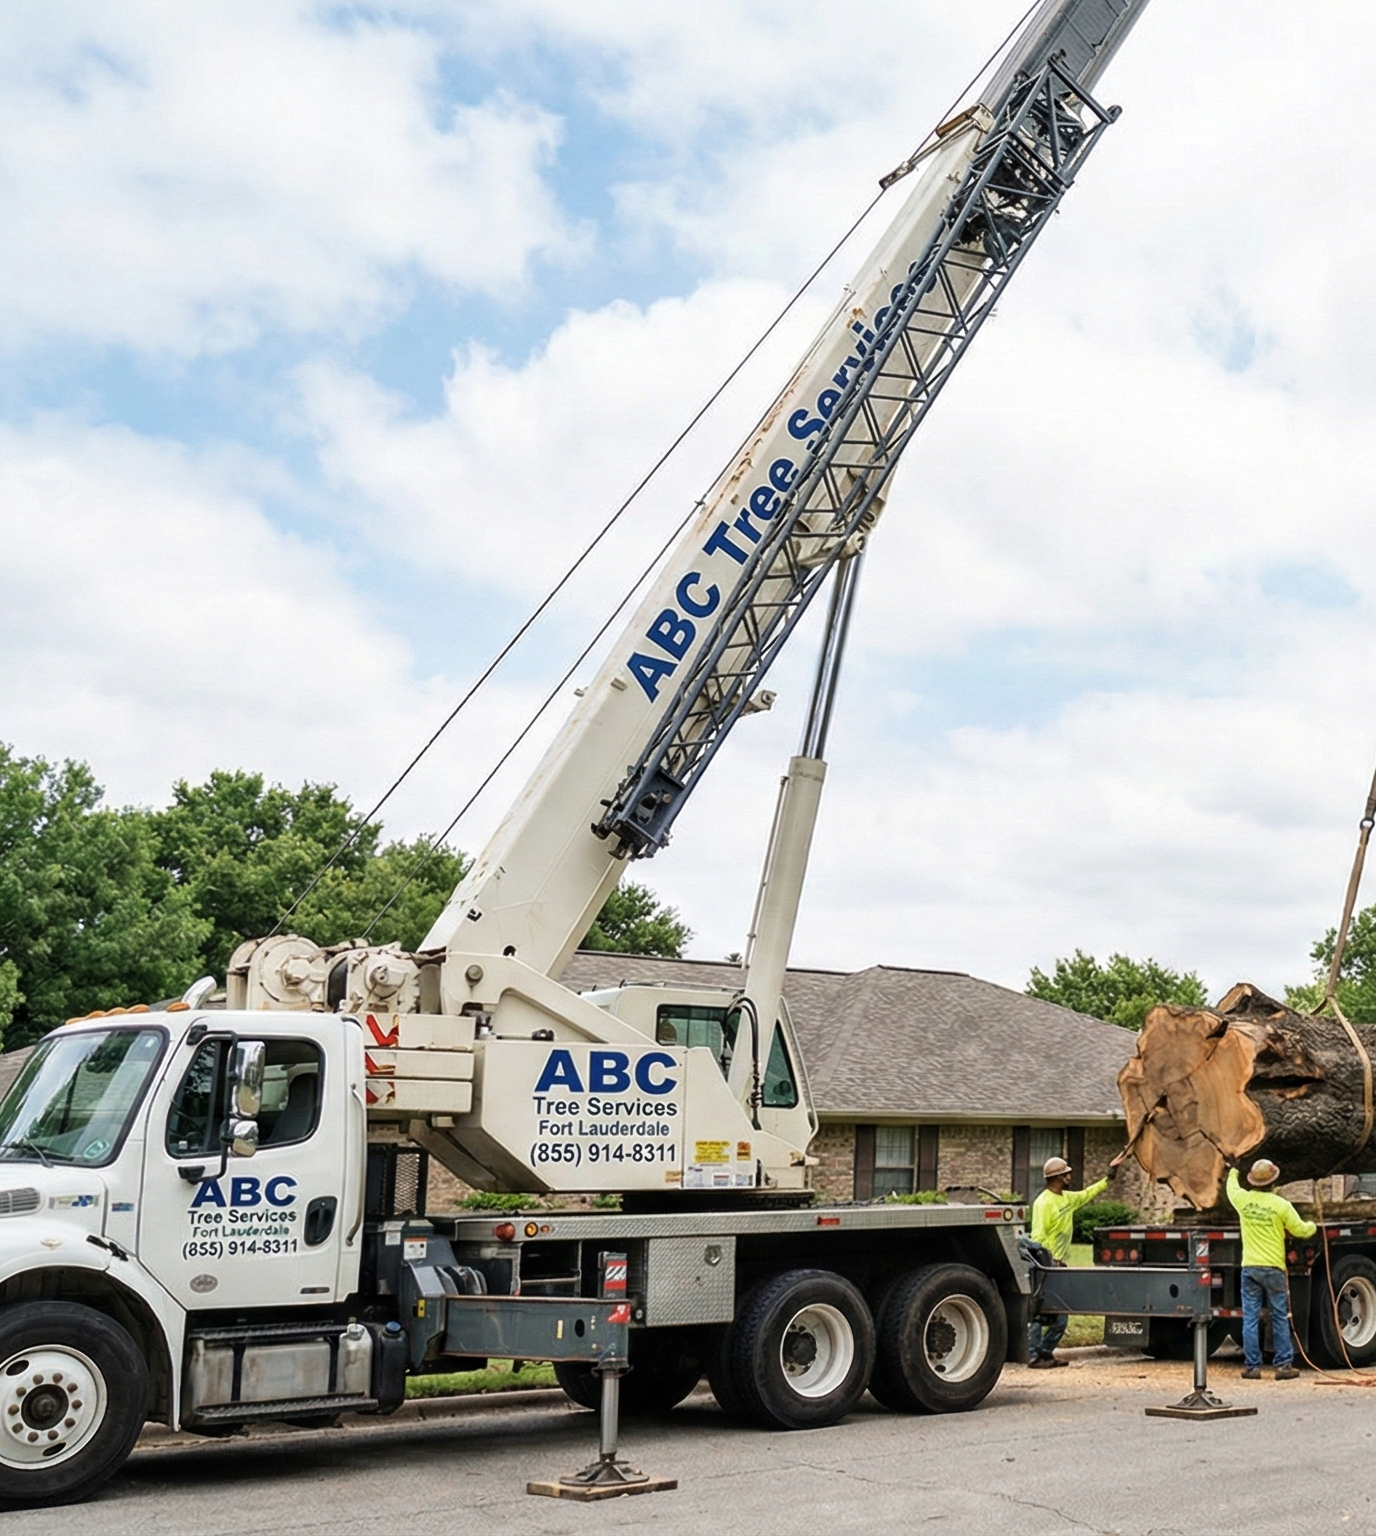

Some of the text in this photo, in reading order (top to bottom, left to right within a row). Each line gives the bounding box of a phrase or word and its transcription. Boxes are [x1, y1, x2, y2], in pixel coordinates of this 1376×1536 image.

[626, 571, 720, 703] ABC
[702, 458, 802, 566] Tree
[534, 1049, 677, 1095] ABC
[532, 1096, 677, 1116] Tree Services
[539, 1120, 670, 1136] Fort Lauderdale
[530, 1143, 581, 1167] (855)
[588, 1143, 676, 1162] 914-8311
[190, 1176, 297, 1208] ABC
[188, 1209, 296, 1224] Tree Services
[192, 1224, 290, 1238] Fort Lauderdale
[182, 1238, 297, 1260] (855) 914-8311
